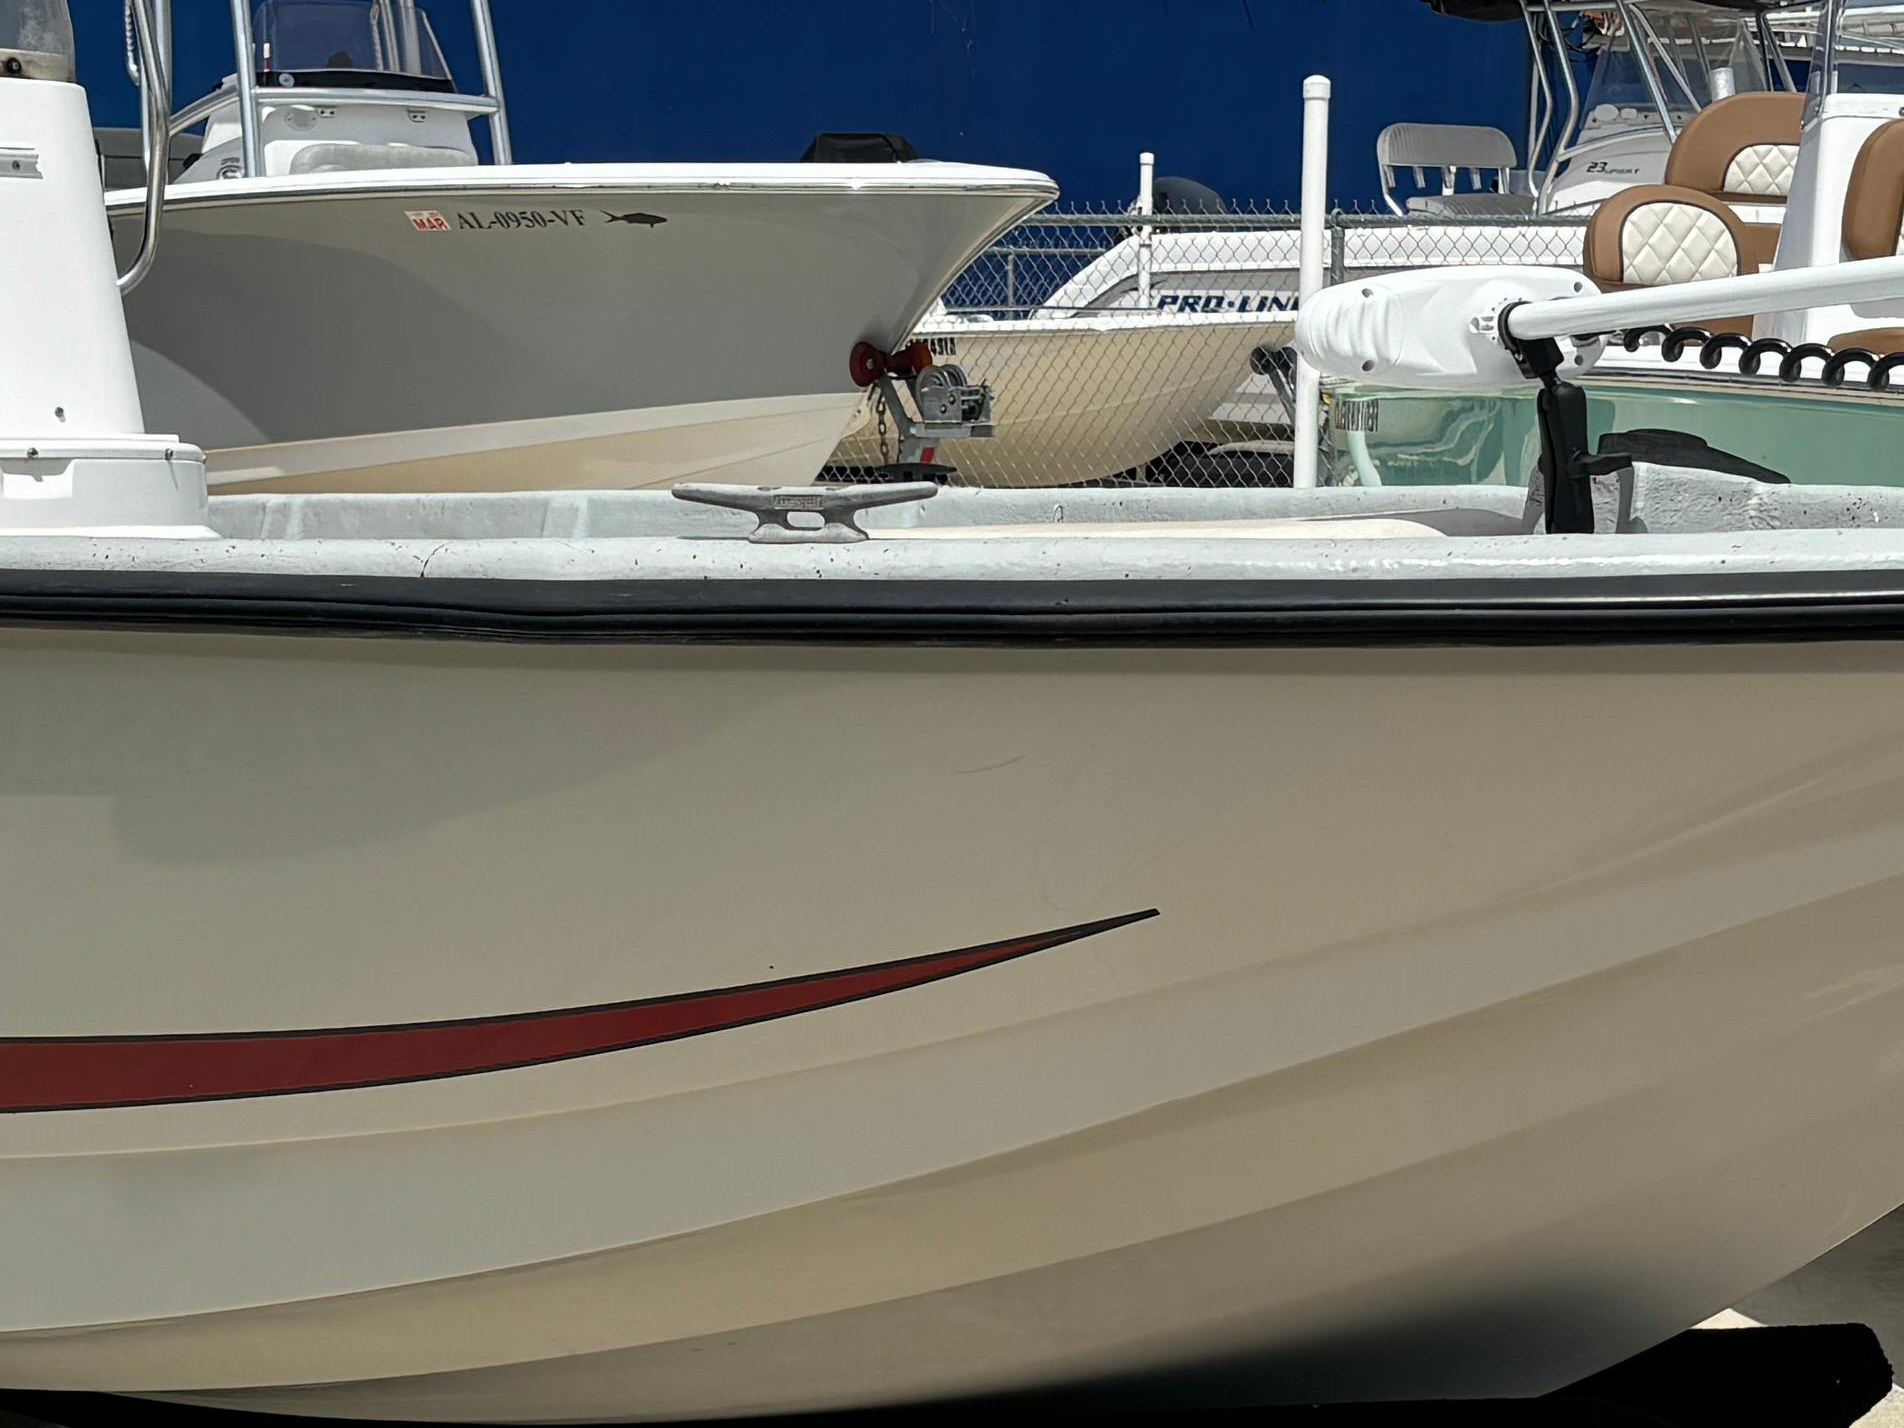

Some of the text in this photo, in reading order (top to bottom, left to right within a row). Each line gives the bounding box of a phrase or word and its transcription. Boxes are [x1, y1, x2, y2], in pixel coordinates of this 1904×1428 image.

[1586, 161, 1609, 173] 23
[412, 209, 586, 231] MAR AL-0950-VF
